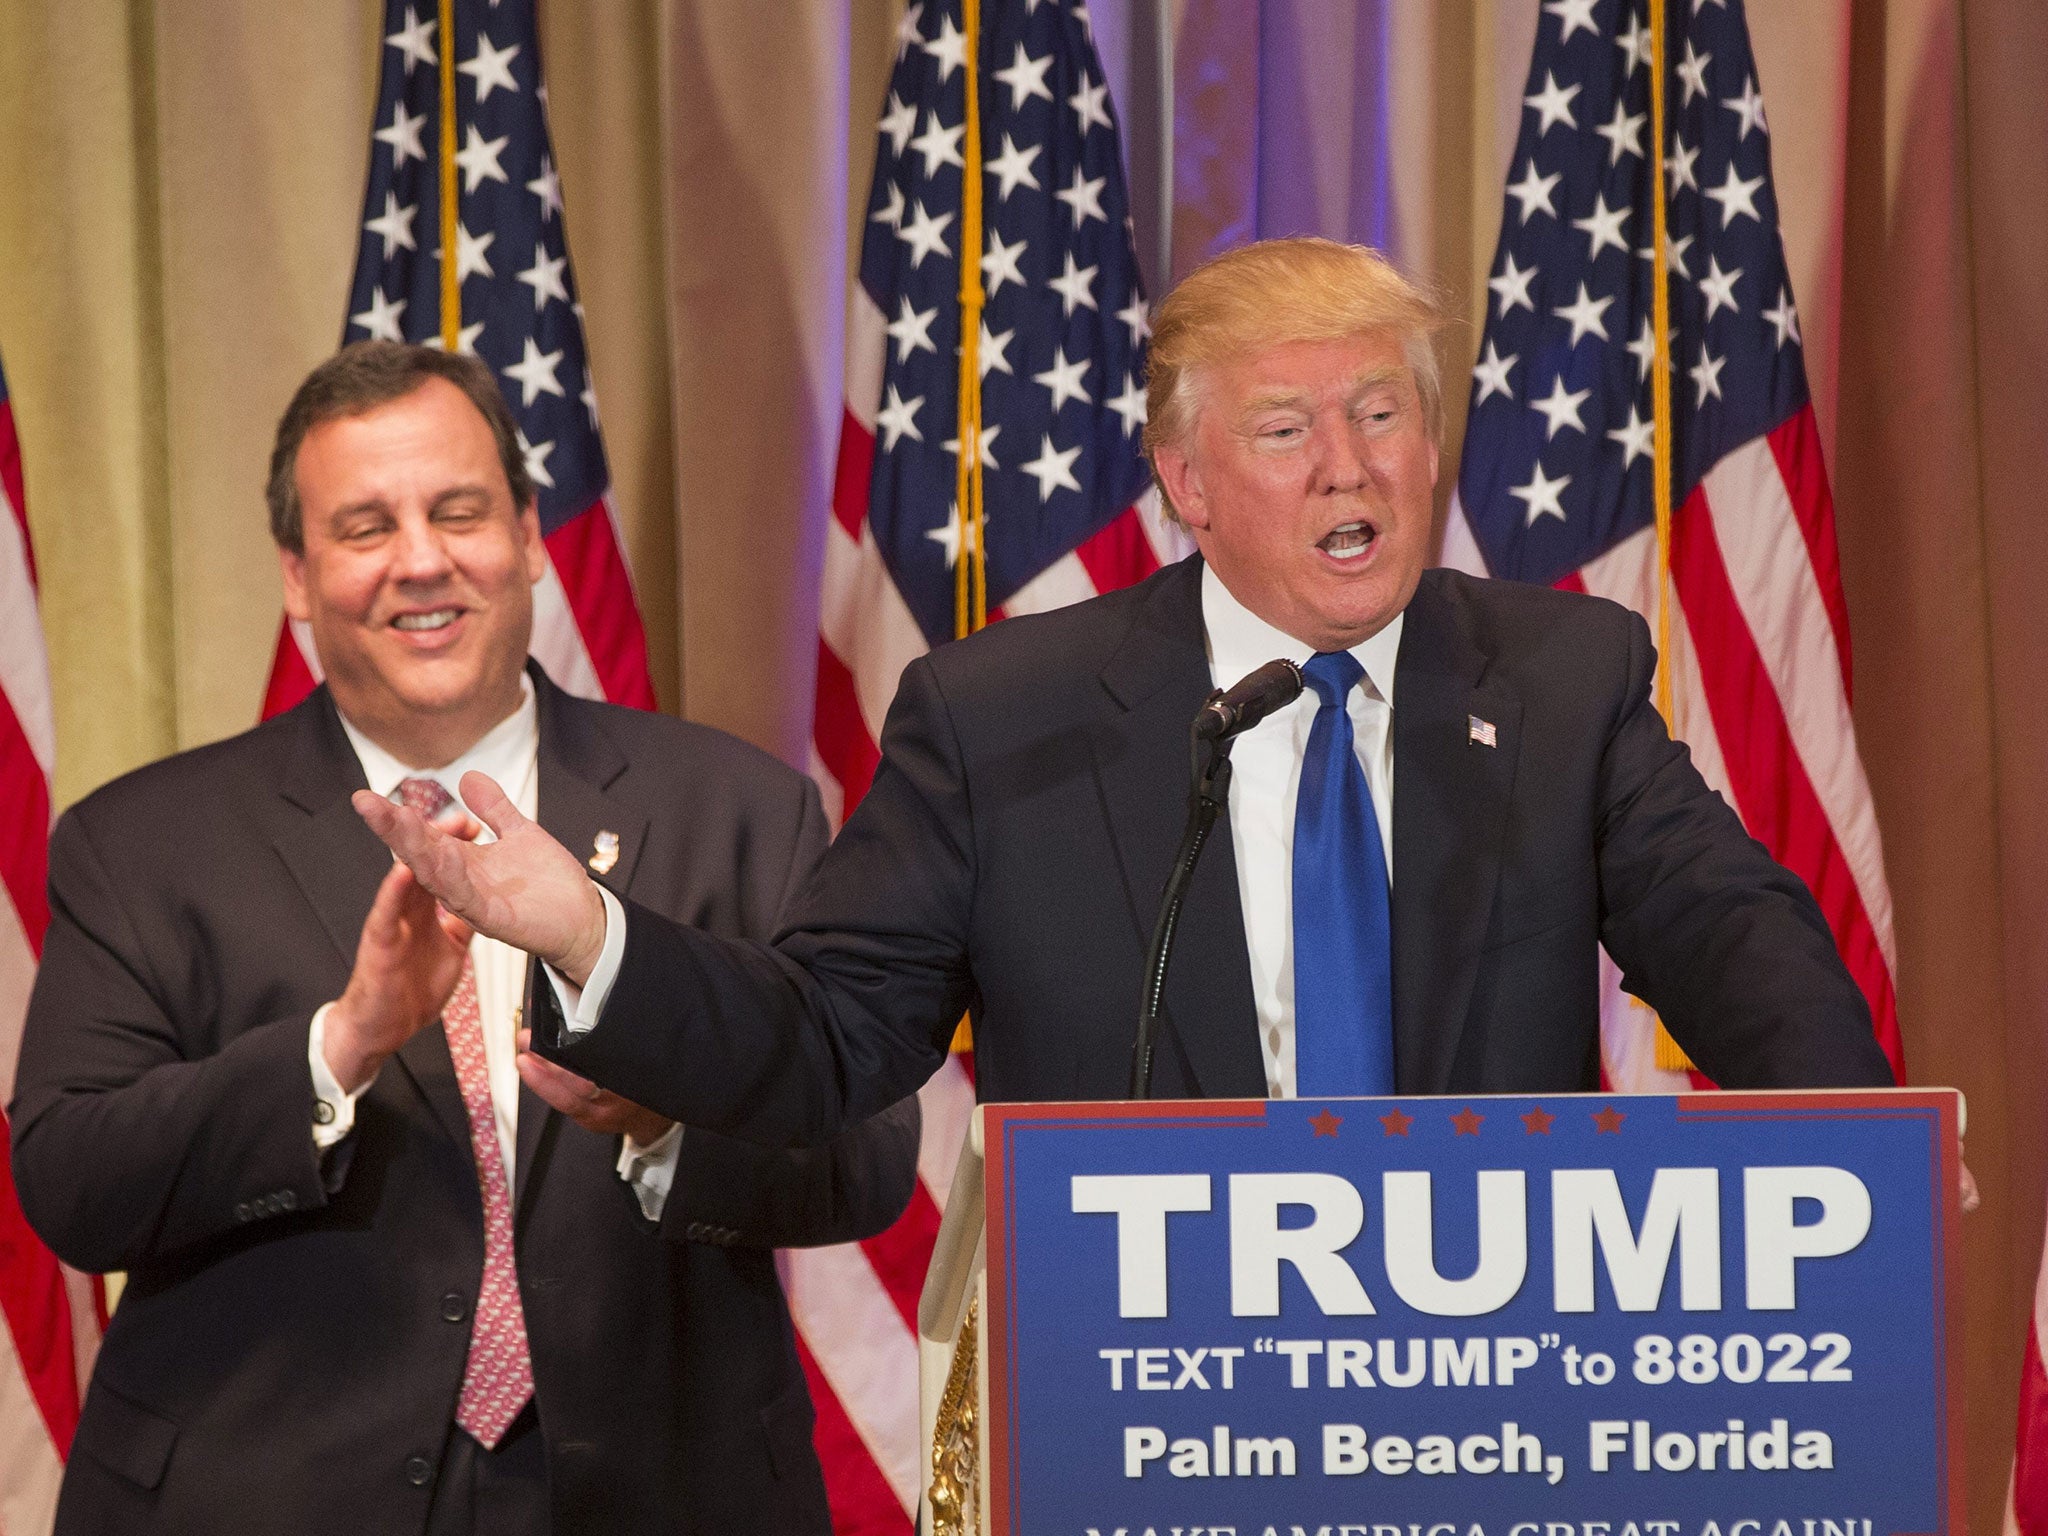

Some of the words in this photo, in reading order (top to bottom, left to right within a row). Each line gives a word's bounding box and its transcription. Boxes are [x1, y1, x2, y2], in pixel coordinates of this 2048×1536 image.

[1070, 1166, 1873, 1318] TRUMP
[1098, 1347, 1245, 1391] TEXT
[1562, 1345, 1617, 1386] to
[1632, 1332, 1853, 1385] 88022
[1124, 1425, 1296, 1478] Palm
[1322, 1422, 1564, 1485] Beach,
[1589, 1418, 1834, 1472] Florida
